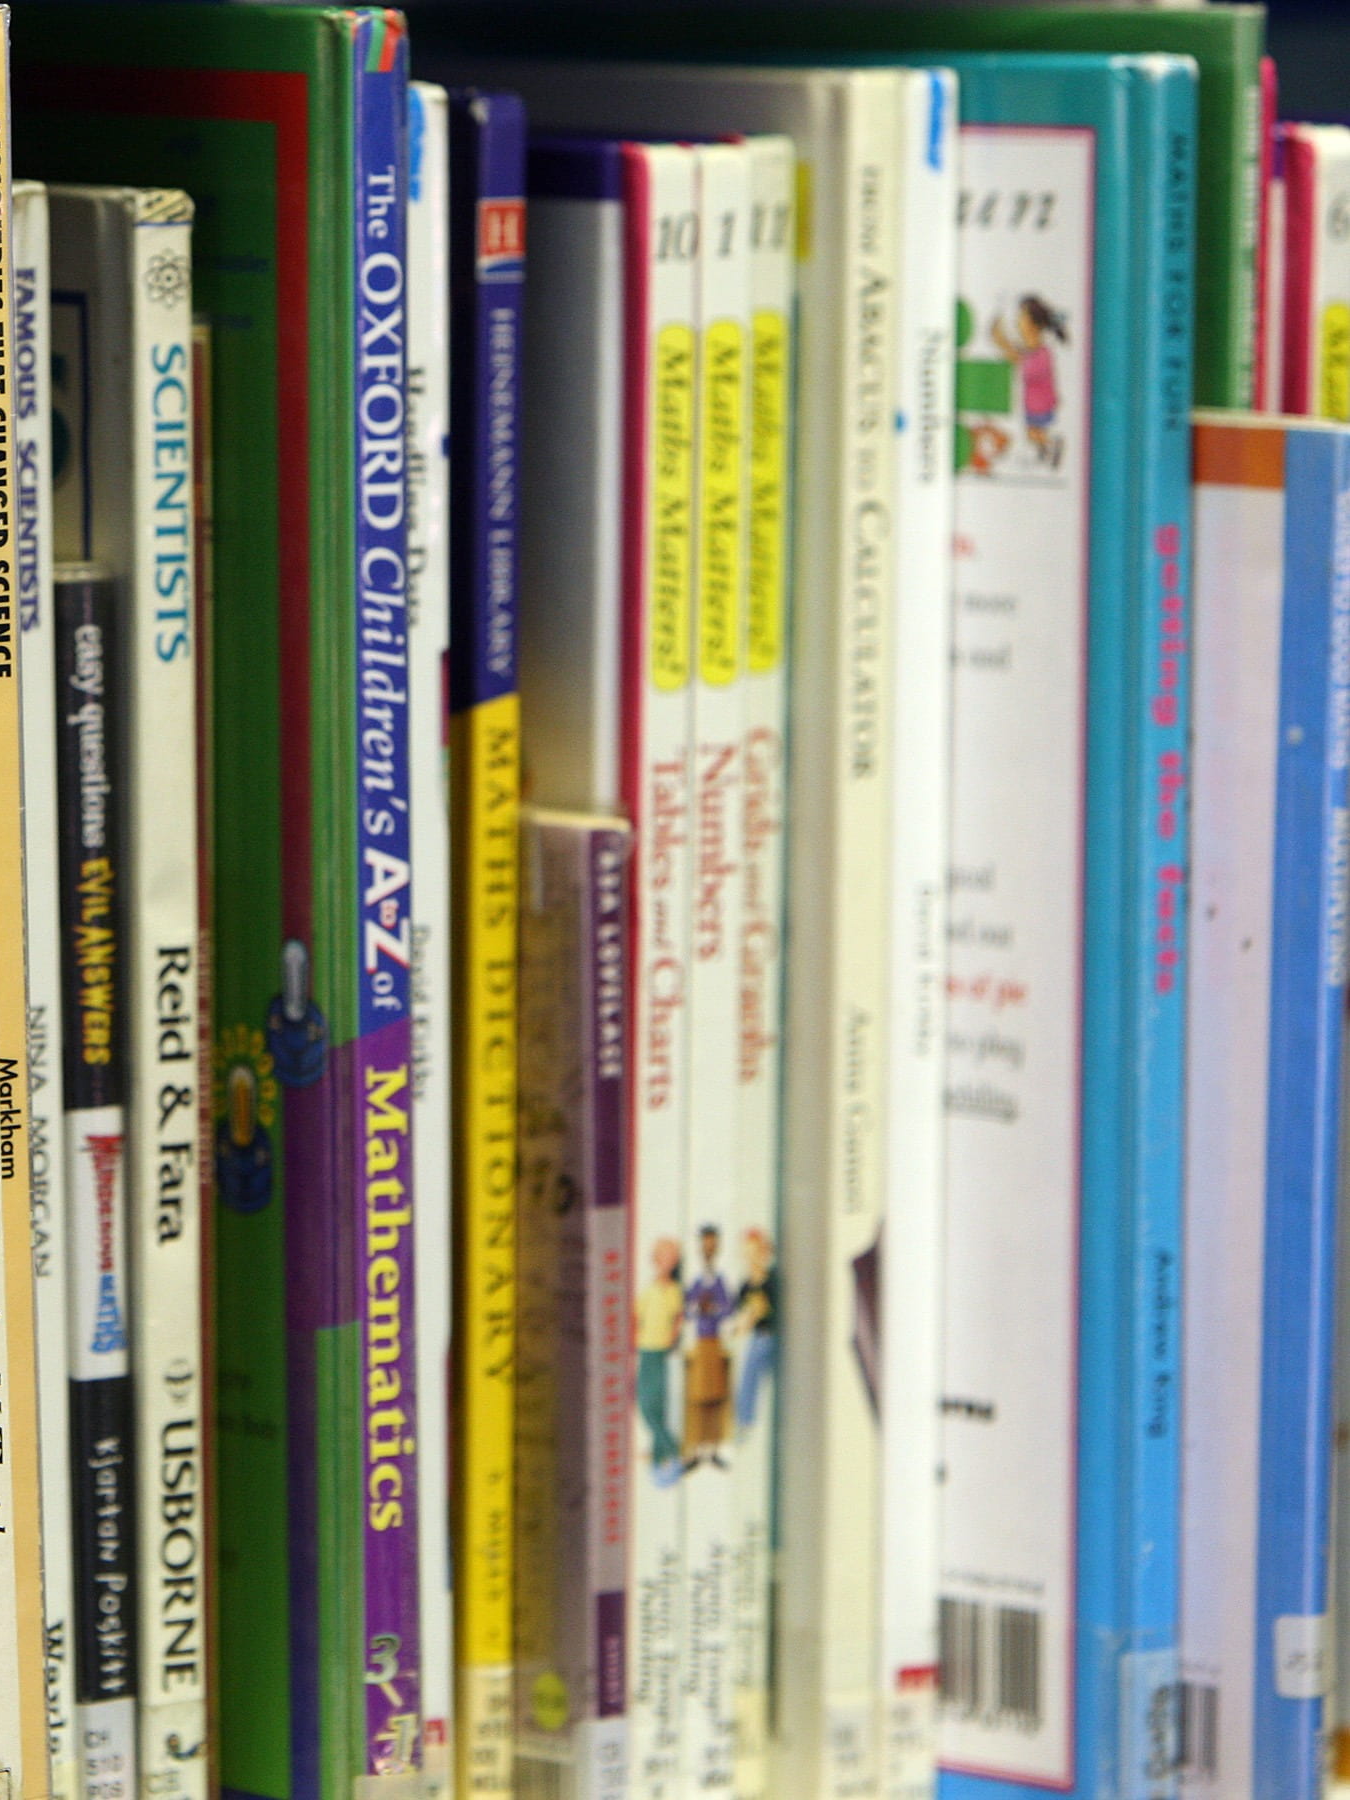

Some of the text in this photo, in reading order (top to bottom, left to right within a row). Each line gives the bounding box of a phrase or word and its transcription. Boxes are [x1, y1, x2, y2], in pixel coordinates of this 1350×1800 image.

[366, 164, 397, 240] The
[14, 266, 41, 634] FAMOUS SCIENTISTS
[151, 342, 191, 664] SCIENTISTS
[359, 252, 406, 532] OXFORD
[359, 545, 407, 837] Children's
[1152, 522, 1187, 726] getting
[66, 624, 118, 1066] easy questions EVIL ANSWERS
[651, 756, 687, 893] Tables
[697, 742, 738, 963] Numbers
[1156, 750, 1185, 841] the
[156, 945, 192, 1246] Reid & Fara
[372, 972, 402, 1011] of
[481, 726, 518, 1389] MATHS DICTIONARY
[647, 958, 685, 1112] Charts
[27, 1004, 51, 1279] NINA MORGAN
[364, 1063, 416, 1533] Mathematics
[160, 1417, 198, 1693] USBORNE
